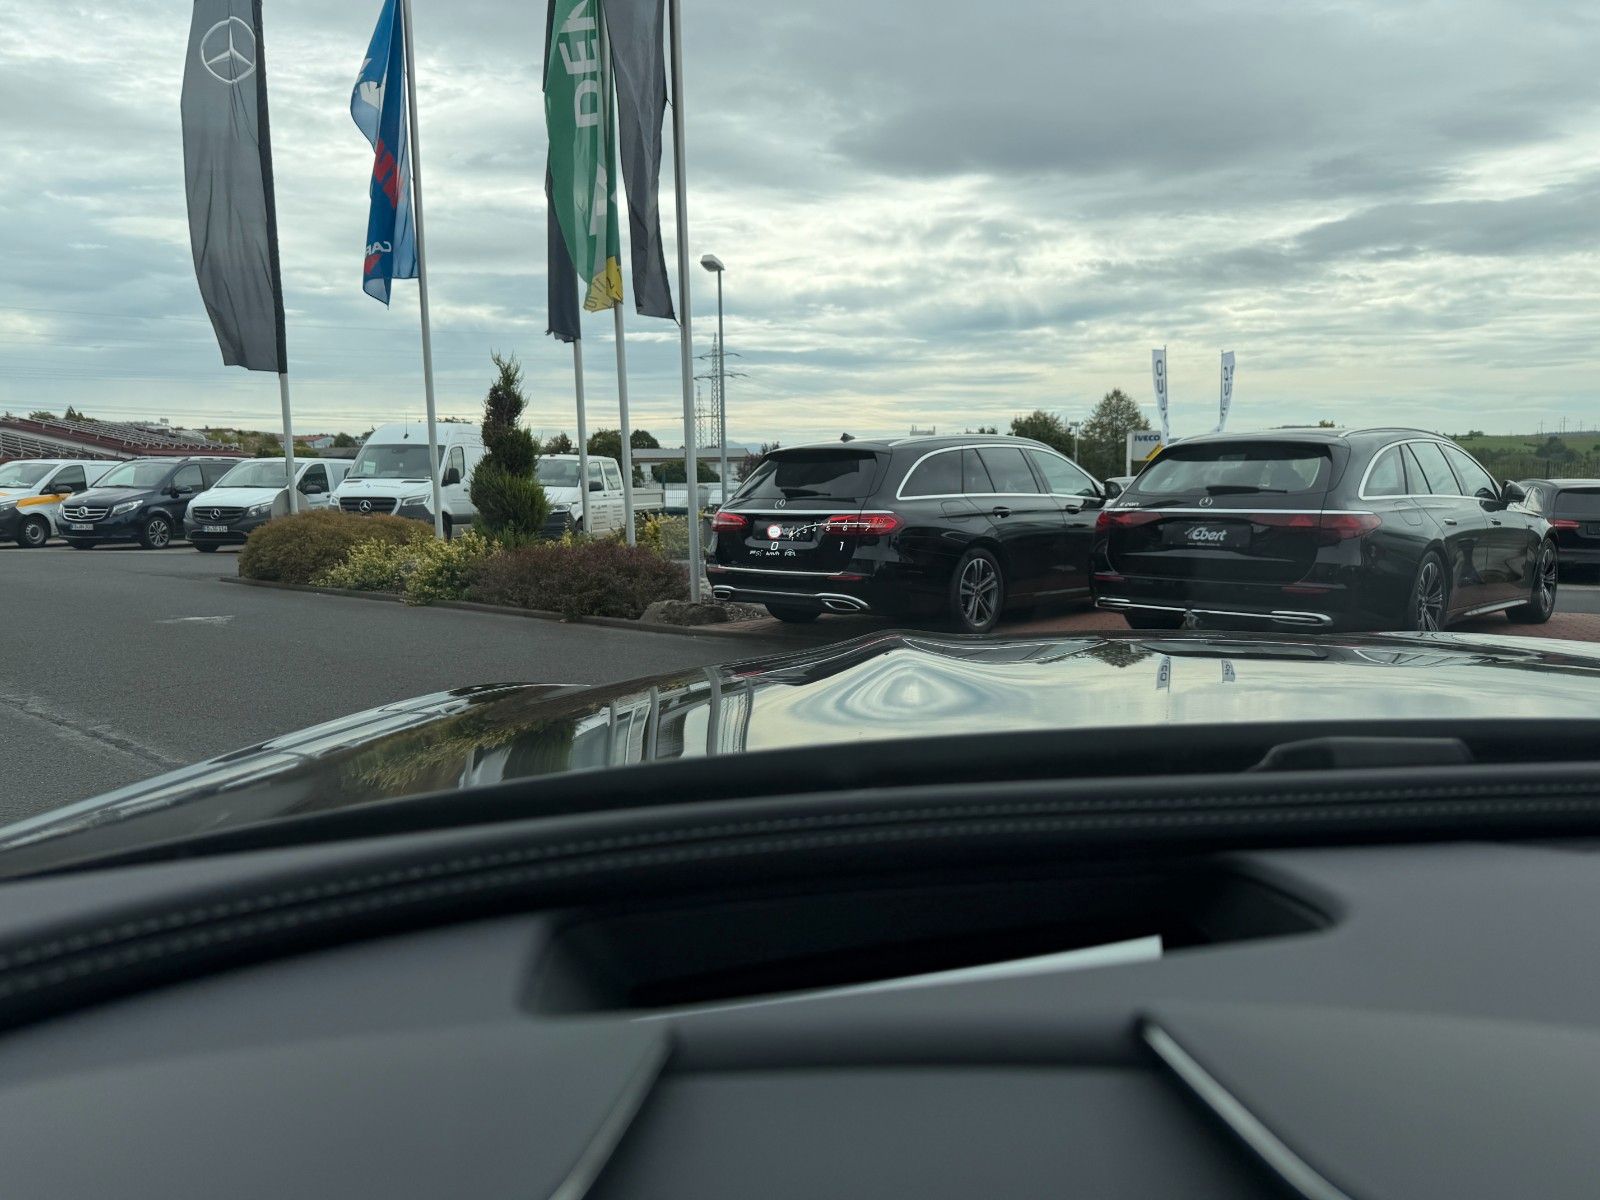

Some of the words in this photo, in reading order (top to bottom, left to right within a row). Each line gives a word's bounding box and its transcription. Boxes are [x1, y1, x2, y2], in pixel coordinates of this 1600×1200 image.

[1135, 434, 1160, 442] IVECO
[1192, 527, 1227, 541] Ebert
[770, 542, 779, 551] 0
[839, 541, 845, 550] 1
